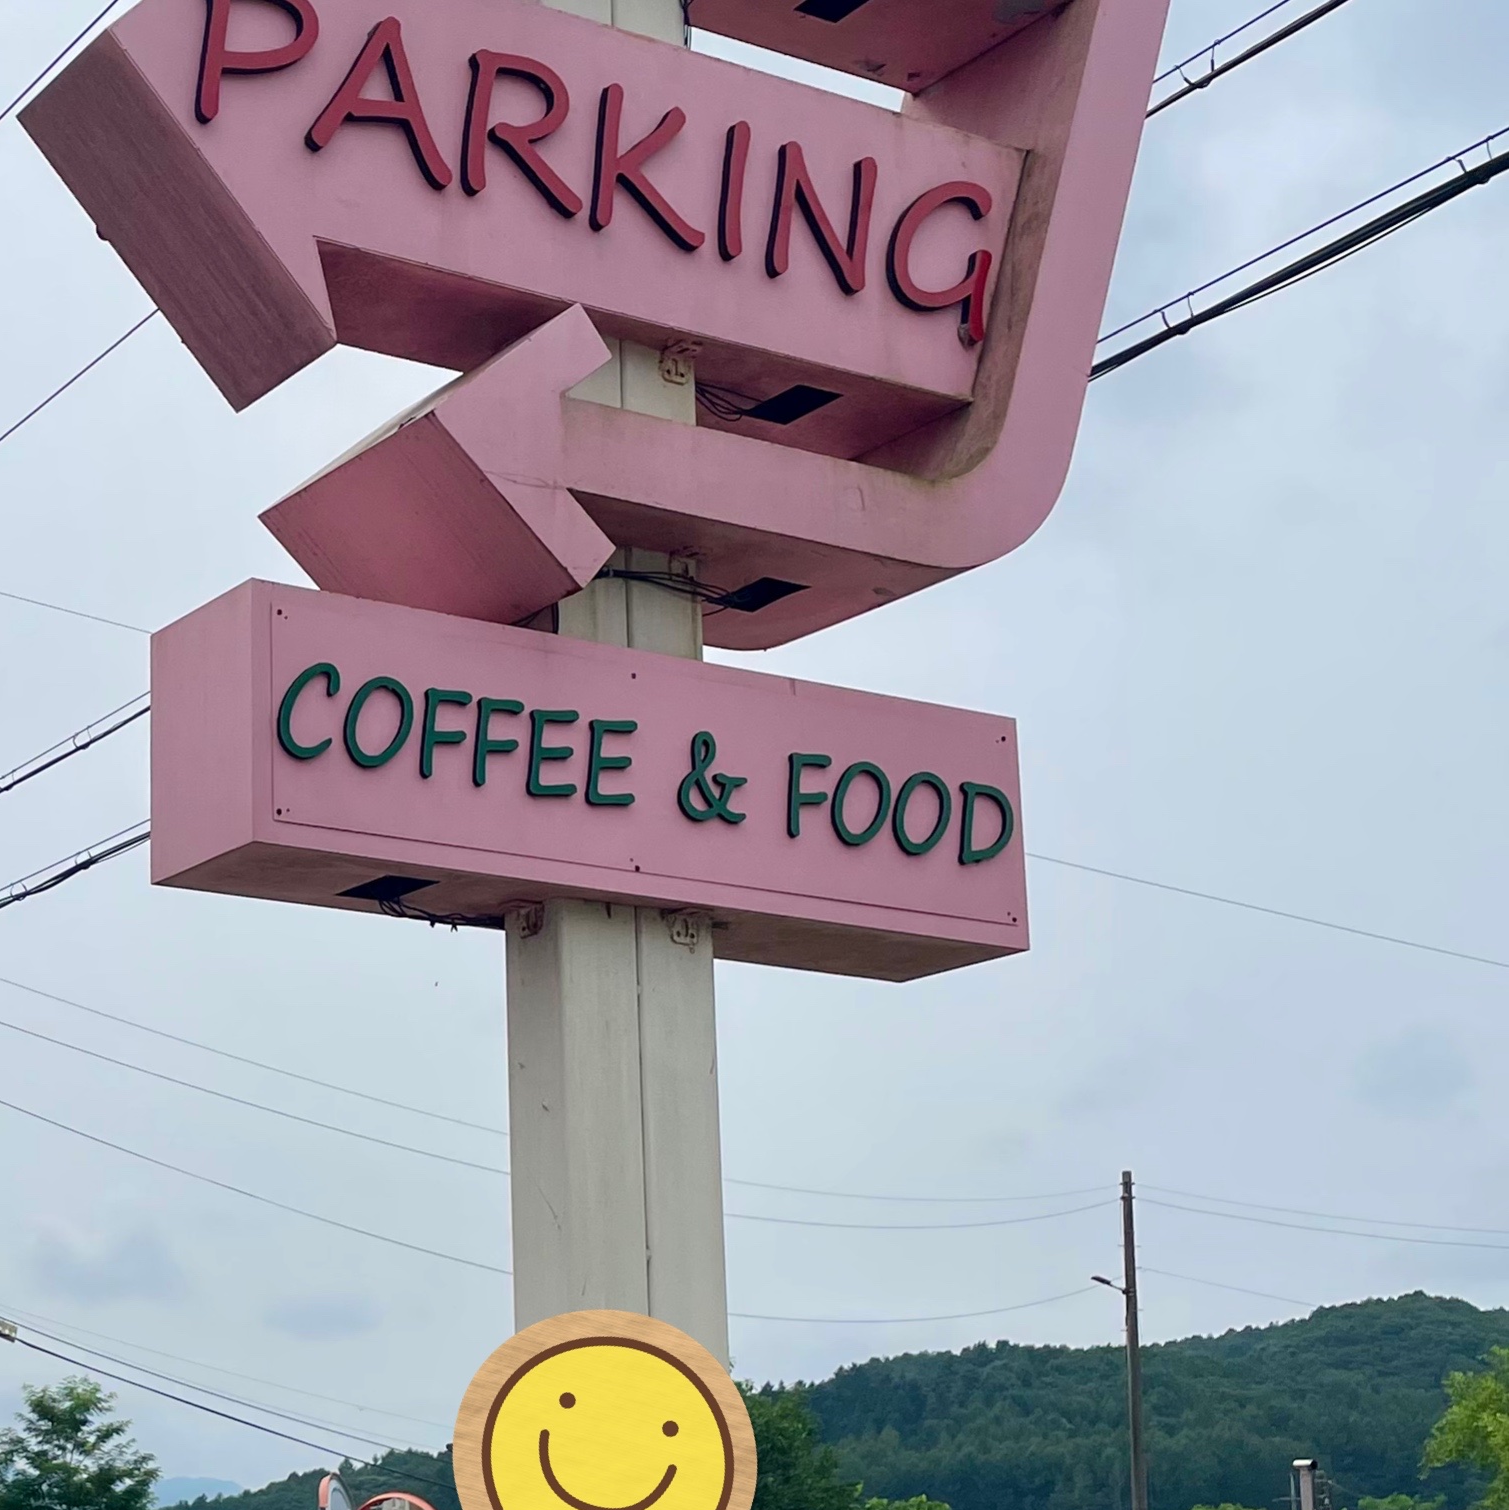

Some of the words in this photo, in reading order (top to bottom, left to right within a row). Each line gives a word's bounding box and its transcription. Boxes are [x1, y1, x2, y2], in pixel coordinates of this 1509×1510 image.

[193, 0, 995, 346] PARKING
[276, 661, 639, 808] COFFEE
[675, 729, 748, 827] &
[785, 750, 1016, 867] FOOD
